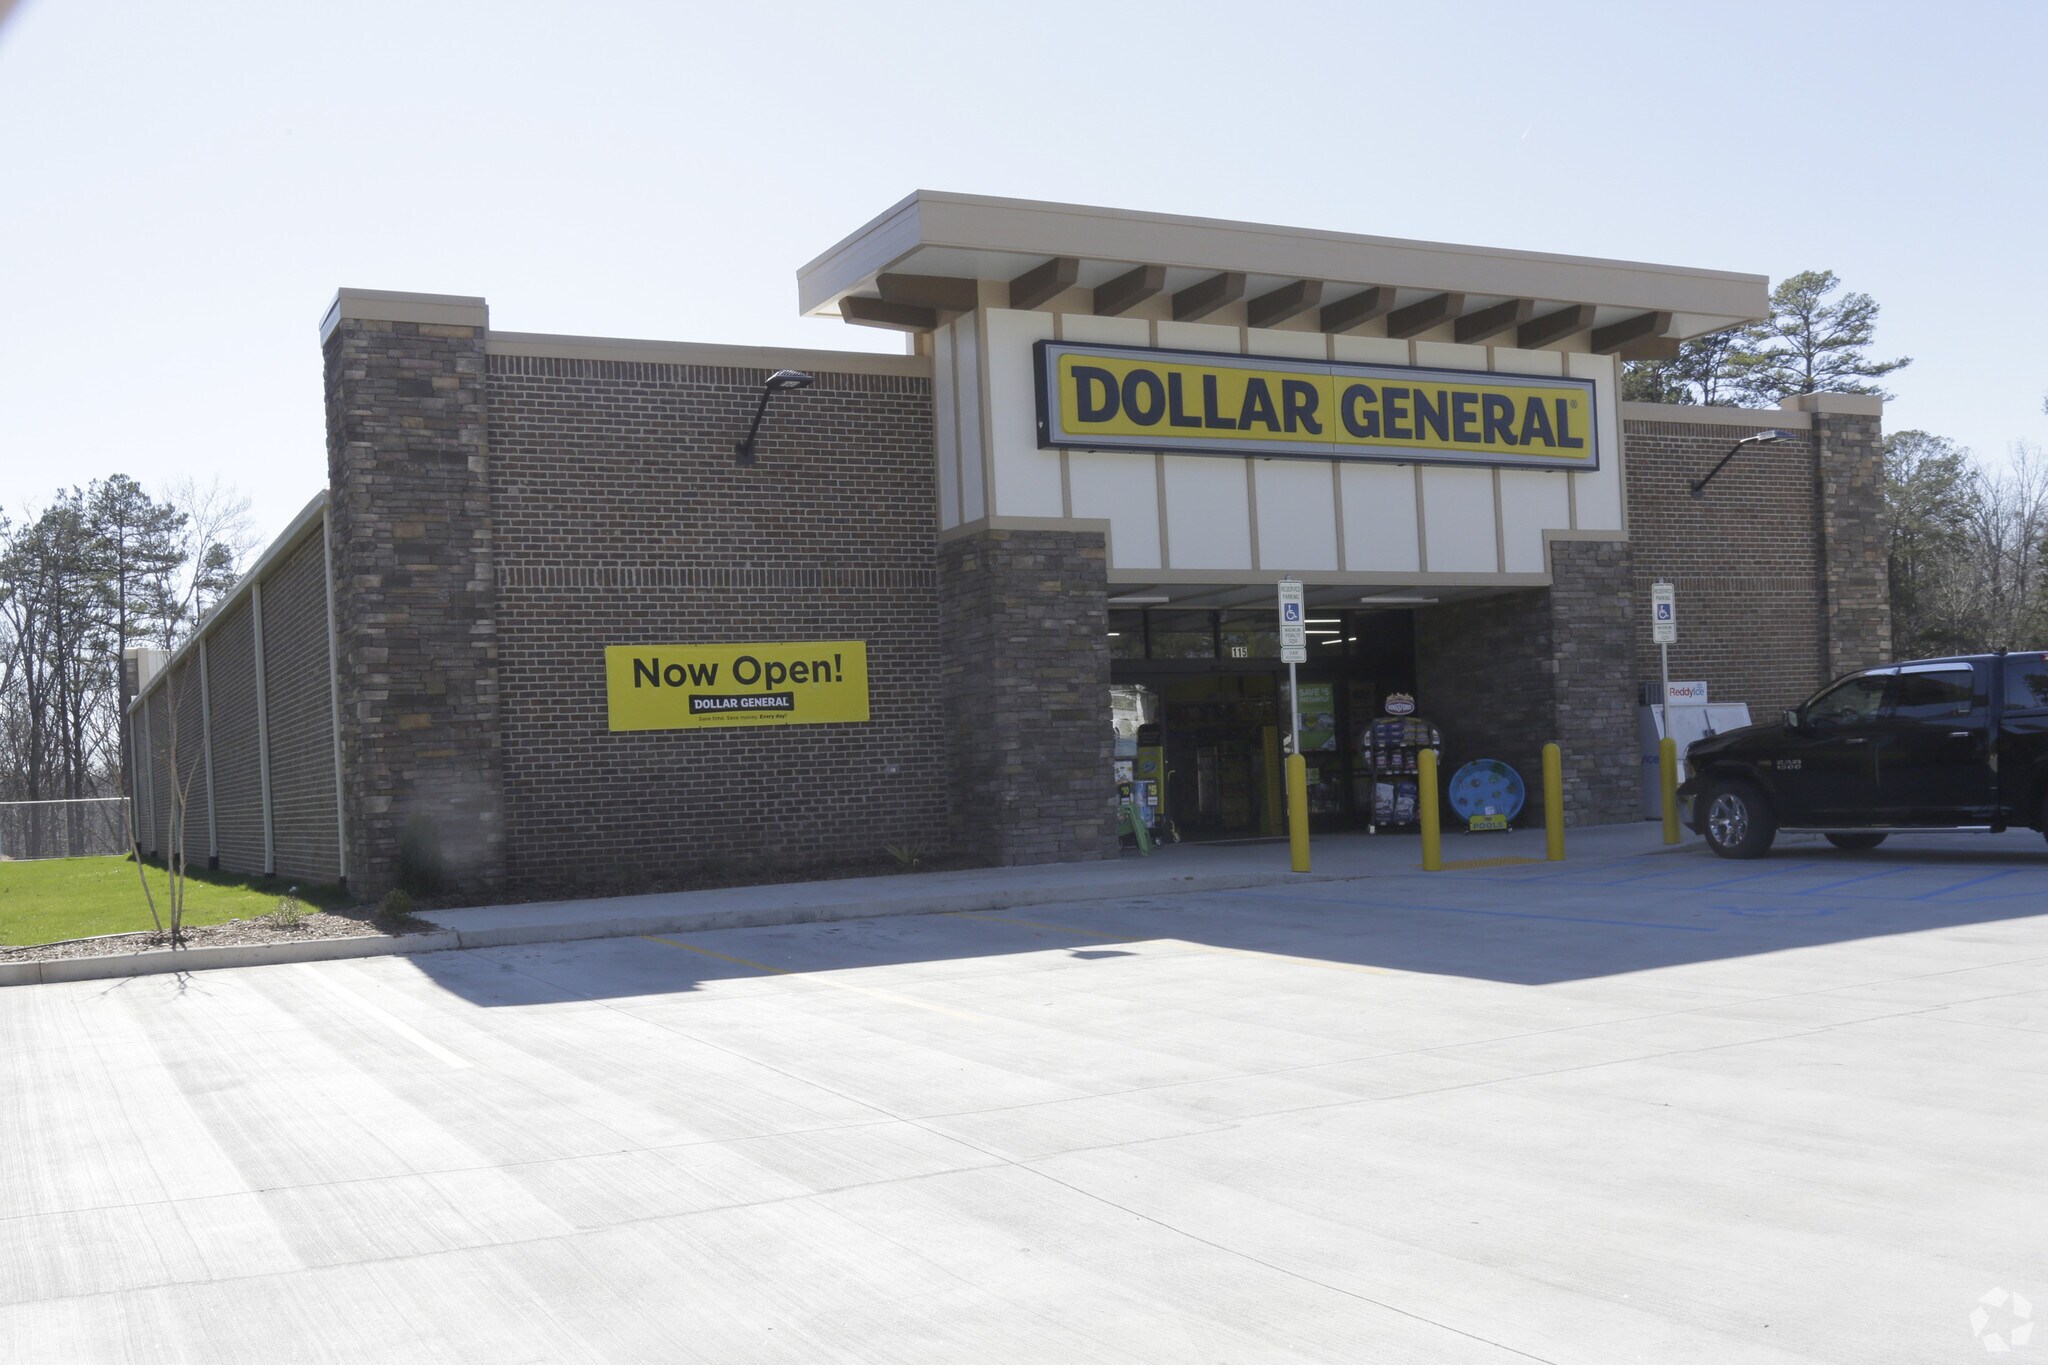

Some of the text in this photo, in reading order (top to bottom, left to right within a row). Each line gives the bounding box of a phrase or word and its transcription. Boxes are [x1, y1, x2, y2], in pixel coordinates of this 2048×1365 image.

[1071, 365, 1584, 449] DOLLAR GENERAL
[1232, 647, 1248, 658] 115
[633, 653, 843, 691] Now Open!
[1299, 687, 1320, 697] SAVE
[694, 697, 789, 710] DOLLAR GENERAL
[1473, 821, 1504, 829] POOLS
